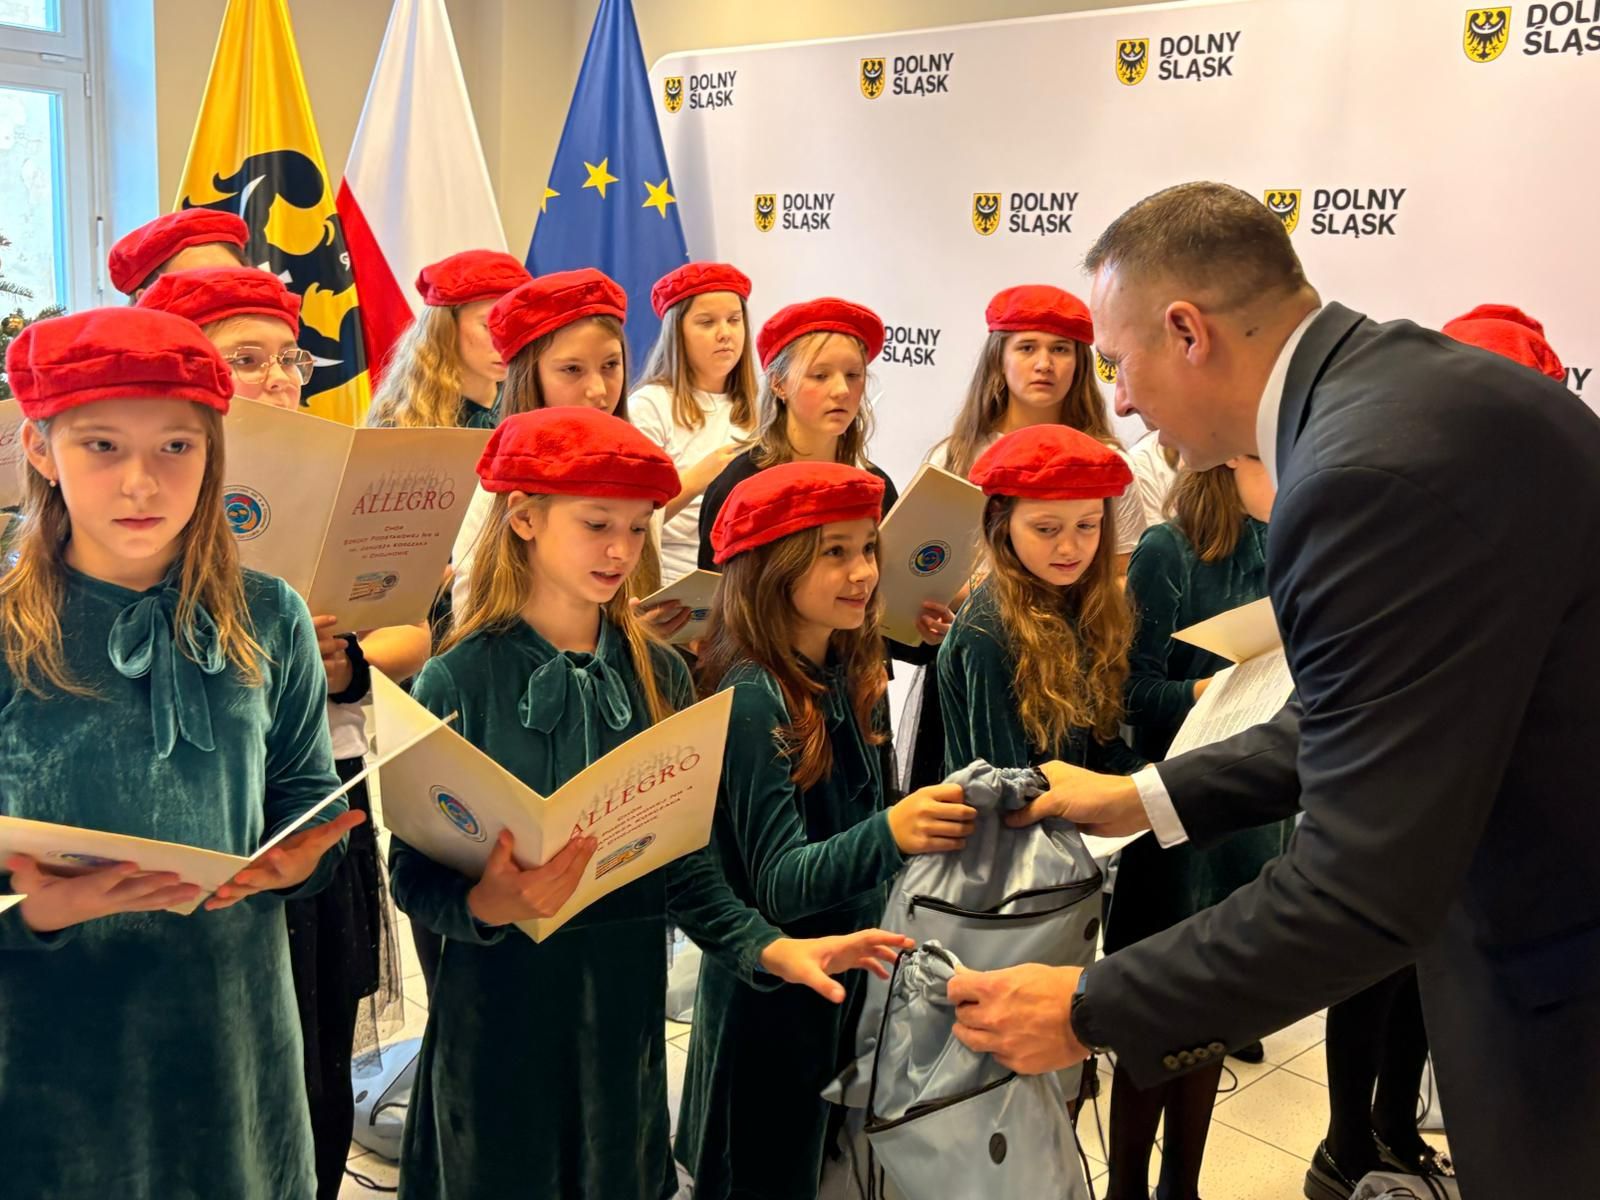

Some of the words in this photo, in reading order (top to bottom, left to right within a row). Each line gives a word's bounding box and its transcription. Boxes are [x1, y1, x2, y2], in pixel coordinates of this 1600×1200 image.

[1160, 31, 1241, 58] DOLNY
[893, 53, 955, 76] DOLNY
[1158, 54, 1234, 82] ŚLĄSK
[690, 70, 737, 91] DOLNY
[892, 72, 950, 97] ŚLĄSK
[689, 89, 734, 111] ŚLĄSK
[782, 193, 836, 212] DOLNY
[1010, 192, 1080, 213] DOLNY
[1313, 188, 1407, 212] DOLNY
[782, 209, 832, 233] ŚLĄSK
[1008, 210, 1073, 236] ŚLĄSK
[1310, 208, 1397, 239] ŚLĄSK
[884, 326, 942, 347] DOLNY
[882, 341, 936, 368] ŚLĄSK
[351, 490, 456, 515] ALLEGRO
[570, 753, 700, 840] ALLEGRO
